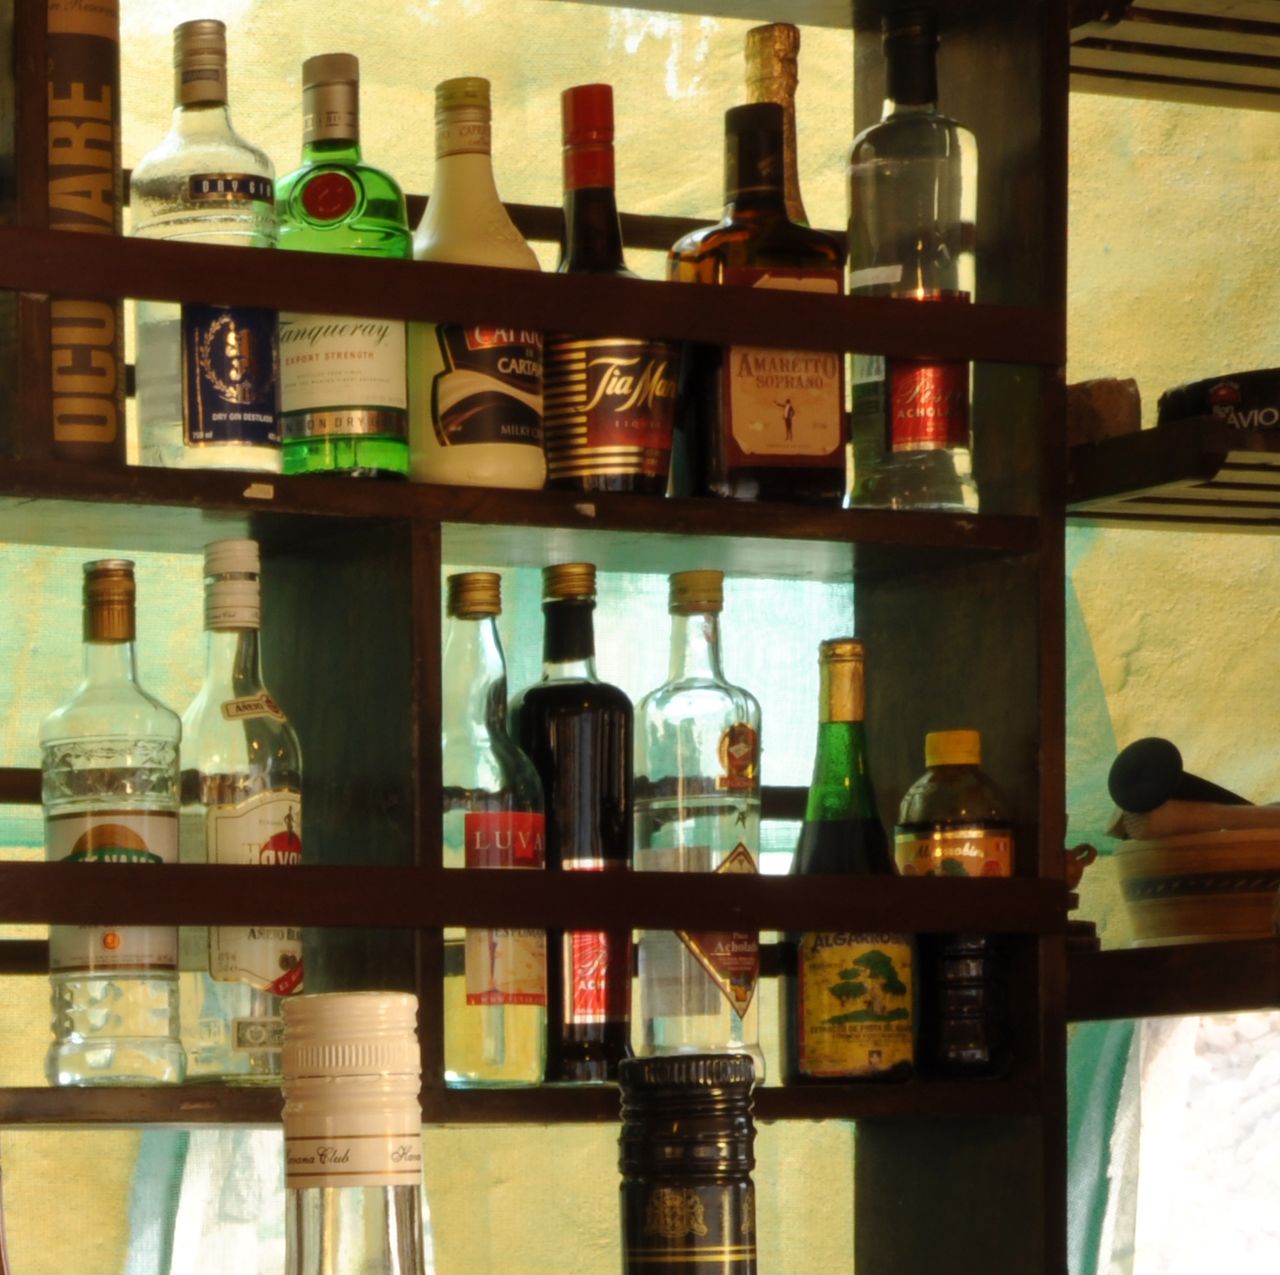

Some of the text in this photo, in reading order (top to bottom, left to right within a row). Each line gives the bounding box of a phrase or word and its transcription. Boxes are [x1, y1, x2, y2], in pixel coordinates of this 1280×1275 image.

[202, 179, 239, 194] DRY
[279, 320, 390, 345] Tanqueray
[285, 351, 375, 367] EXPORT STRENGTH
[497, 357, 542, 377] CARTA
[736, 352, 838, 379] AMARETTO
[571, 356, 641, 413] Tia
[755, 374, 824, 389] SOPRANO
[474, 831, 545, 850] LUVA
[315, 1144, 351, 1165] Club
